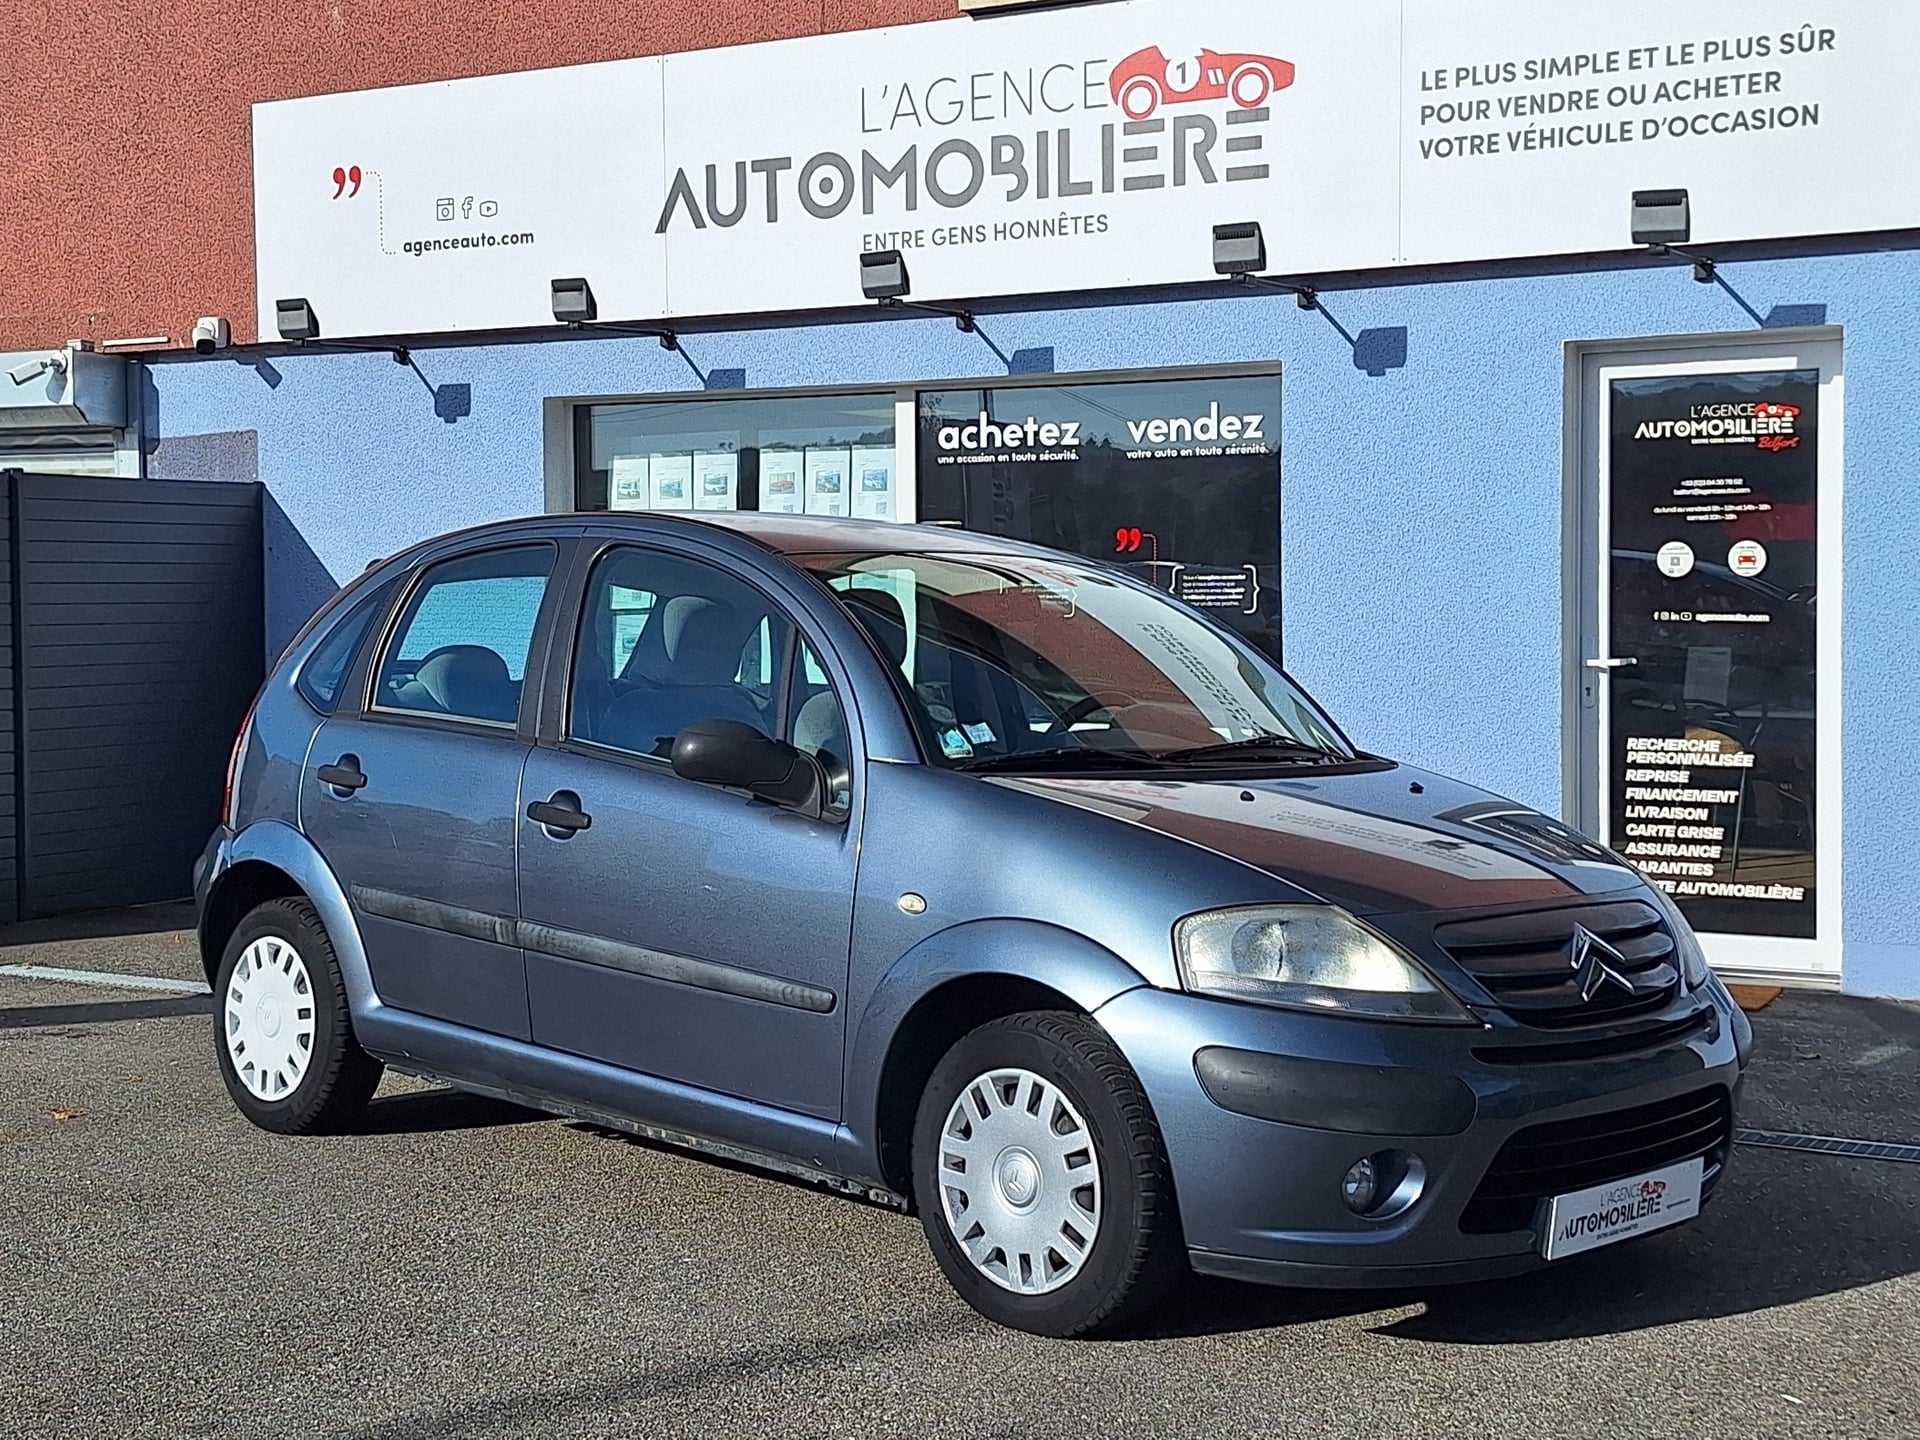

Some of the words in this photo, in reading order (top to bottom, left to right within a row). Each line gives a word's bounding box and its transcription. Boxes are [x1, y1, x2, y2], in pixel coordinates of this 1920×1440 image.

[1421, 70, 1447, 91] LE
[1455, 62, 1516, 88] PLUS
[1523, 51, 1620, 81] SIMPLE
[1627, 47, 1660, 71] ET
[1666, 43, 1694, 66] LE
[1703, 35, 1771, 62] PLUS
[1779, 23, 1836, 55] SÛR
[861, 59, 1110, 132] L'AGENCE
[1420, 98, 1491, 126] POUR
[1497, 88, 1600, 119] VENDRE
[1607, 83, 1647, 107] OU
[1652, 71, 1782, 104] ACHETER
[1419, 132, 1500, 159] VOTRE
[1507, 121, 1633, 152] VÉHICULE
[1642, 103, 1820, 140] D'OCCASION
[863, 229, 925, 251] ENTRE
[932, 224, 986, 246] GENS
[994, 212, 1109, 242] HONNÊTES
[403, 230, 534, 256] agenceauto.com
[1690, 403, 1756, 418] L'AGENCE
[937, 411, 1081, 450] achetez
[1127, 402, 1264, 444] vendez
[937, 456, 954, 465] une
[957, 452, 995, 463] occasion
[997, 453, 1009, 462] en
[1012, 452, 1037, 462] toute
[1126, 449, 1152, 459] votre
[1154, 447, 1178, 458] auto
[1180, 447, 1193, 457] en
[1195, 445, 1223, 456] toute
[1626, 737, 1720, 752] RECHERCHE
[1626, 752, 1755, 767] PERSONNALISÉE
[1625, 769, 1690, 783] REPRISE
[1625, 787, 1738, 804] FINANCEMENT
[1625, 806, 1708, 821] LIVRAISON
[1626, 824, 1676, 837] CARTE
[1677, 825, 1724, 840] GRISE
[1625, 842, 1721, 858] ASSURANCE
[1676, 881, 1804, 900] AUTOMOBILIÈRE
